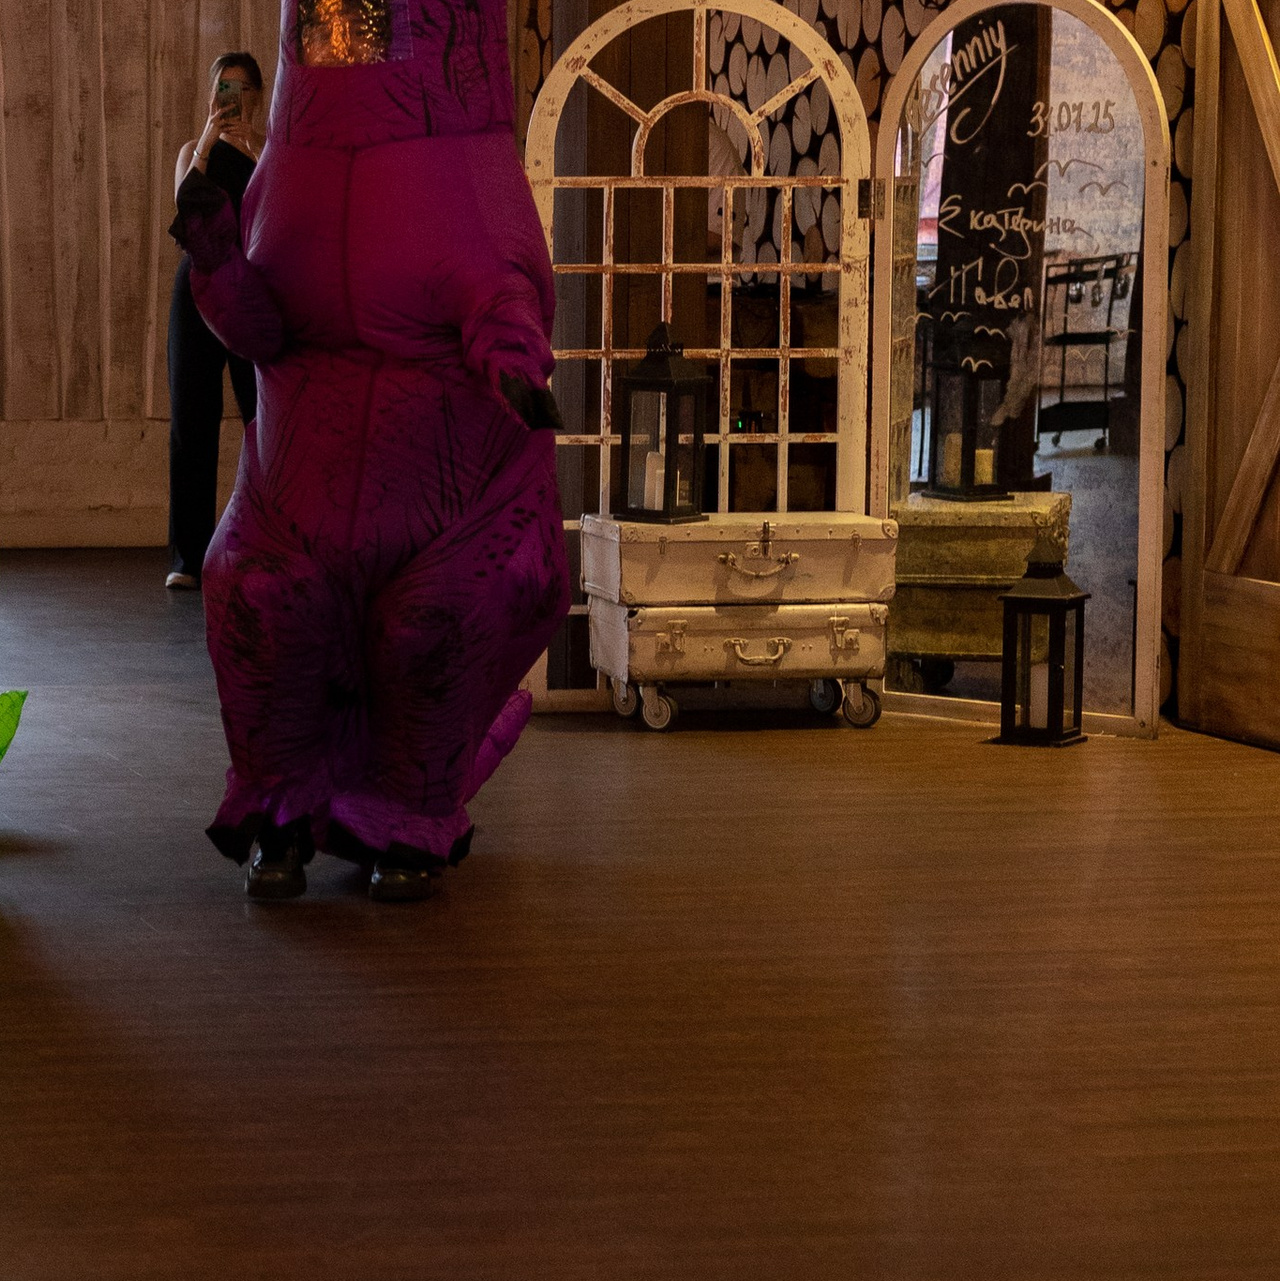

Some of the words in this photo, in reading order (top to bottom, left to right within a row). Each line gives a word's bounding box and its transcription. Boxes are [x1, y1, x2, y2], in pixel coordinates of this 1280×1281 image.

[1027, 100, 1116, 138] 31.07.25
[938, 194, 1094, 260] Екатерина
[928, 256, 1034, 311] Павел
